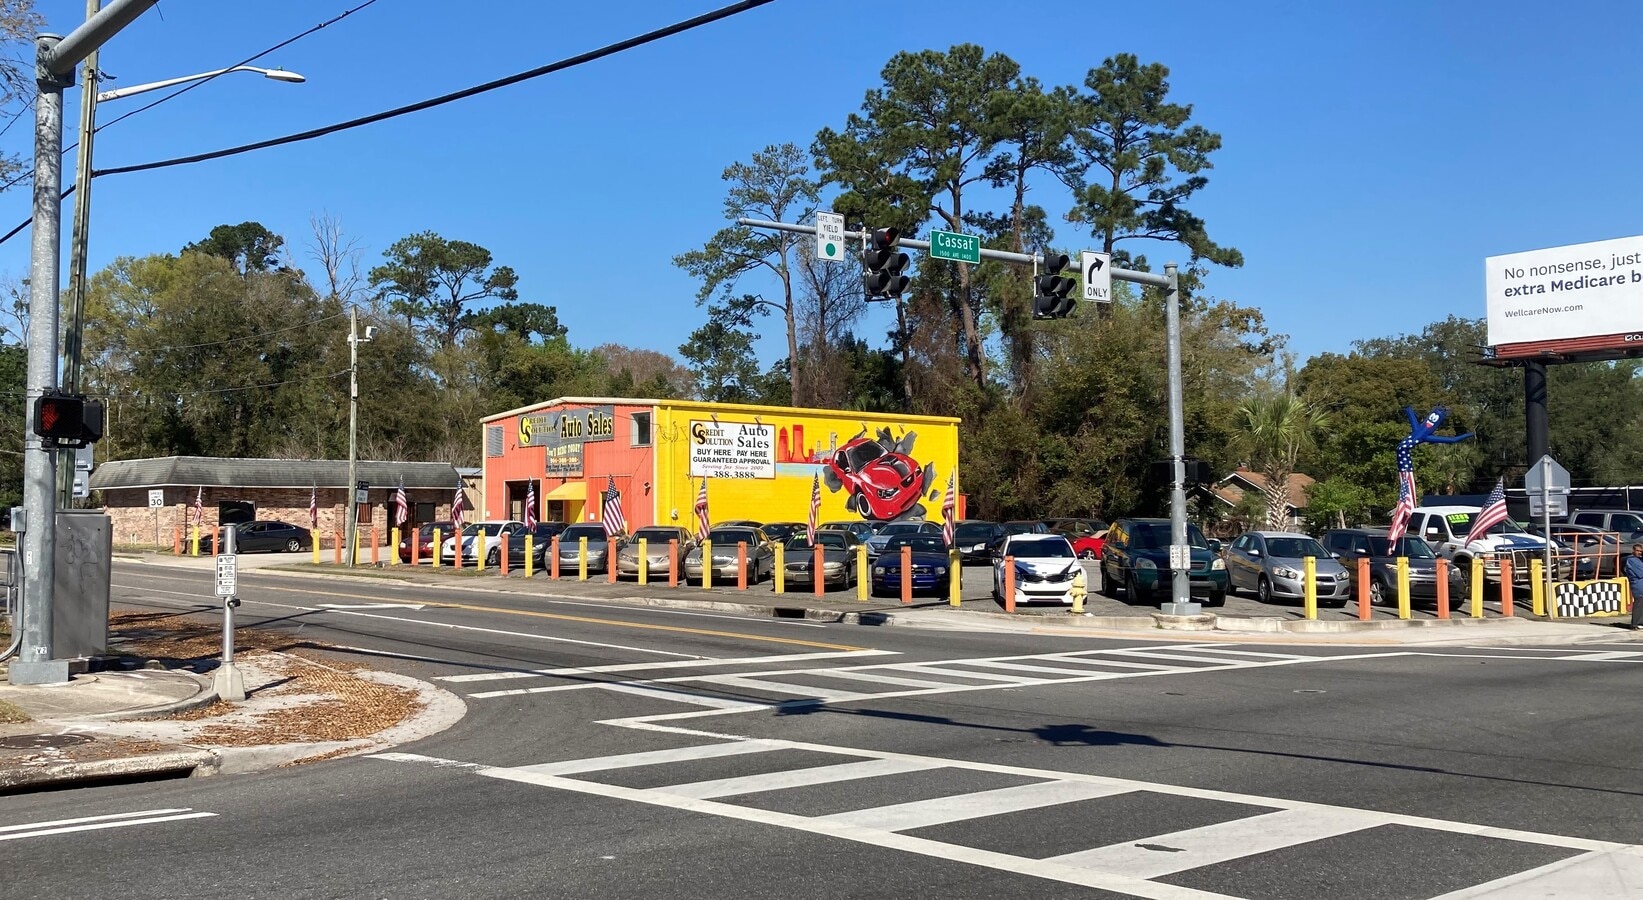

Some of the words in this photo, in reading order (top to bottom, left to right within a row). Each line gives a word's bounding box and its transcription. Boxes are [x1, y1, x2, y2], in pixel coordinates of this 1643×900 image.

[823, 224, 838, 233] YIELD
[938, 233, 973, 250] Cassat
[1504, 267, 1525, 280] No
[1530, 258, 1606, 276] nonsense,
[1610, 252, 1641, 271] just
[1504, 284, 1546, 297] extra
[1551, 274, 1626, 292] Medicare
[1087, 286, 1108, 298] ONLY
[1504, 304, 1583, 318] WellcareNow.com
[560, 415, 582, 438] Auto
[587, 412, 613, 436] Sales
[739, 424, 768, 436] Auto
[697, 430, 733, 446] SOLUTION
[737, 436, 769, 449] Sales
[697, 448, 711, 456] BUY
[750, 450, 767, 458] HERE
[692, 456, 738, 464] GUARANTEED
[713, 470, 756, 479] 388-3888
[151, 498, 163, 506] 30
